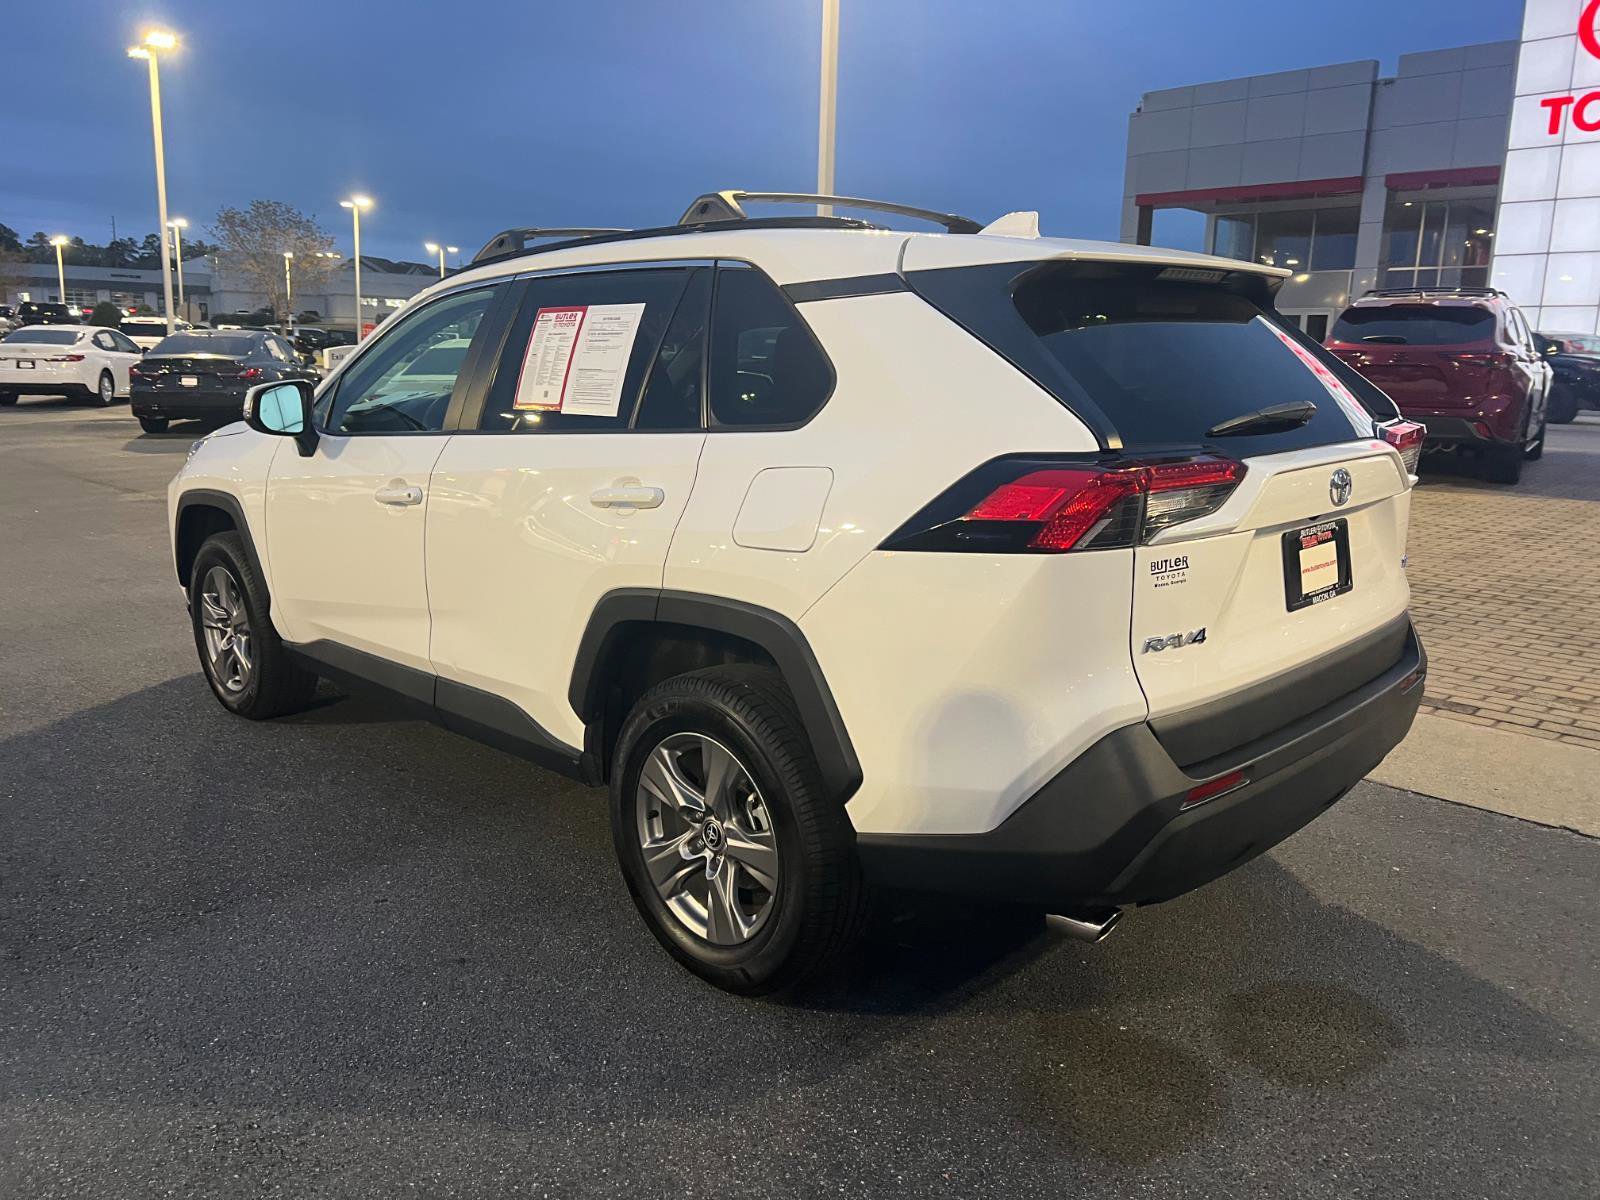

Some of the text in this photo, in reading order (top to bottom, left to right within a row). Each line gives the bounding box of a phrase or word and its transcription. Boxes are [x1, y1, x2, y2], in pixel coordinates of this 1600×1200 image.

[1156, 571, 1186, 581] TOYOTA
[1329, 590, 1337, 598] GA
[1141, 627, 1207, 655] RAV4
